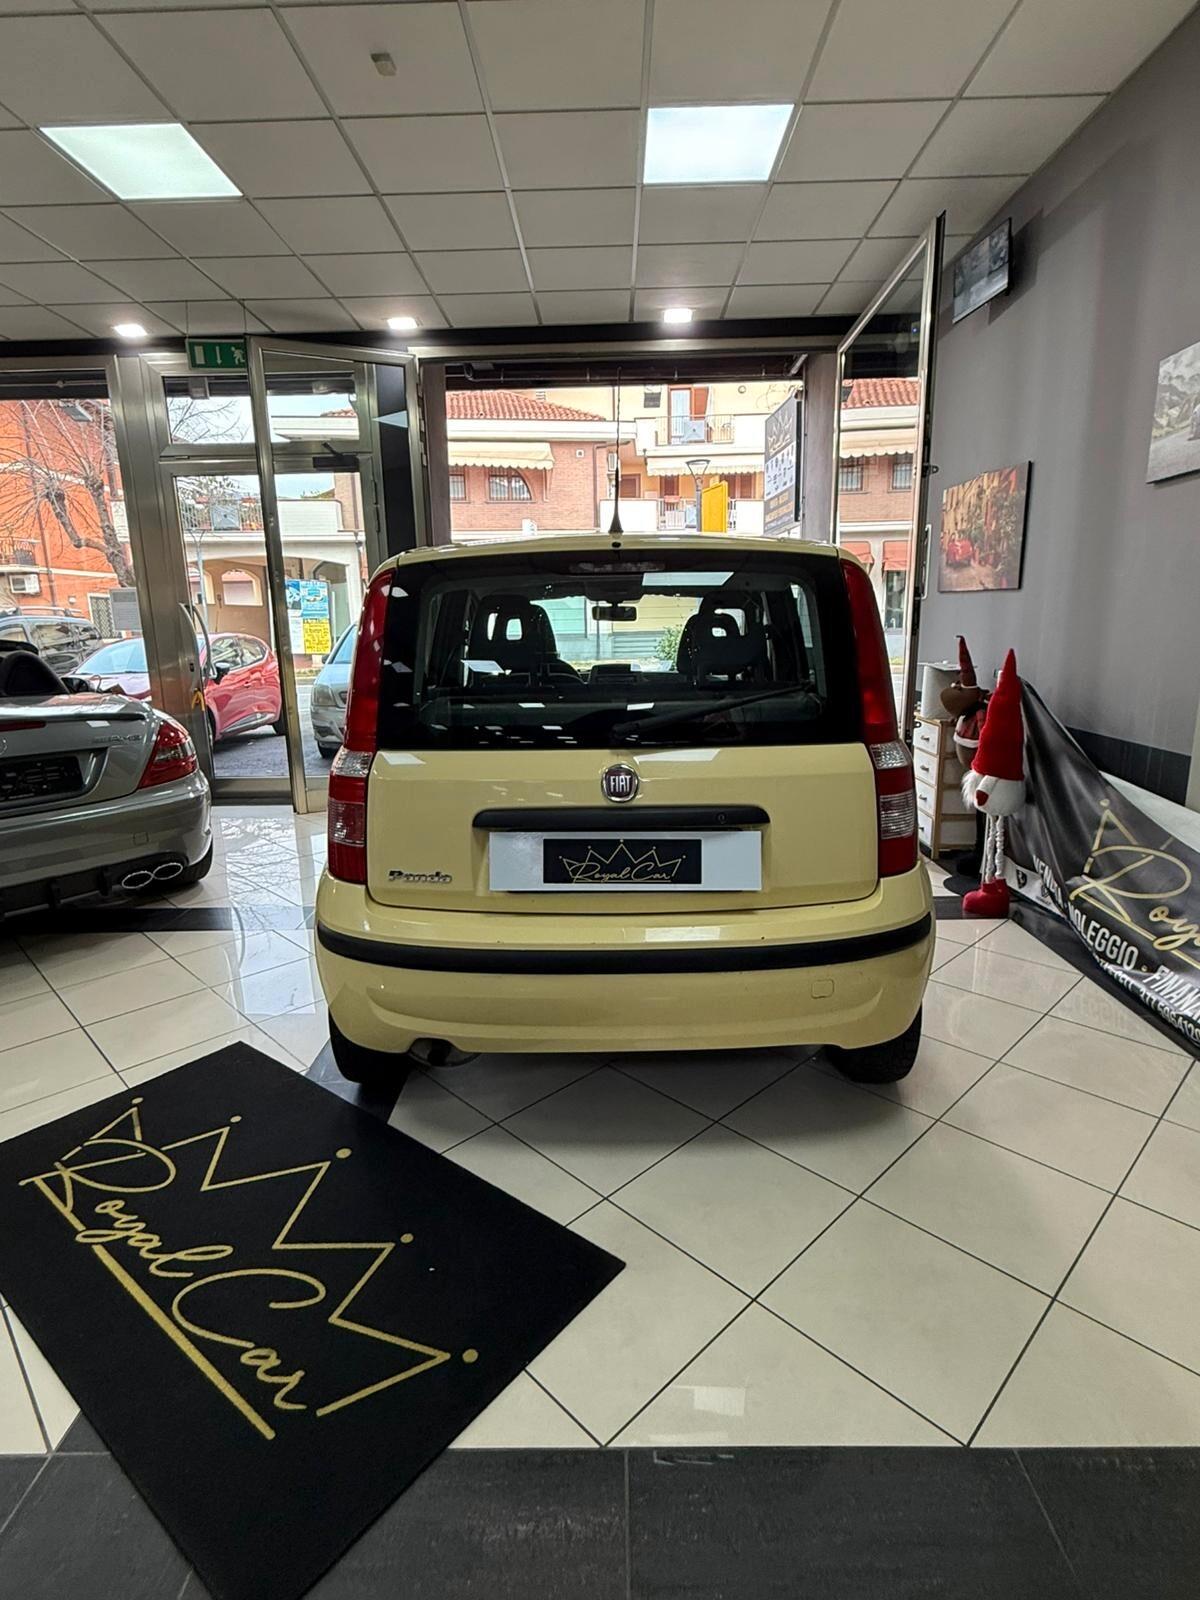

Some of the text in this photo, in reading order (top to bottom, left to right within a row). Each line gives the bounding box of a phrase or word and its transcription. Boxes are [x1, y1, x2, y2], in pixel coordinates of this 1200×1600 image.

[610, 775, 631, 792] FIAT
[388, 869, 453, 884] Panda
[569, 862, 671, 884] Royal Car
[1069, 845, 1200, 951] Roy
[19, 1138, 326, 1410] Royal Car
